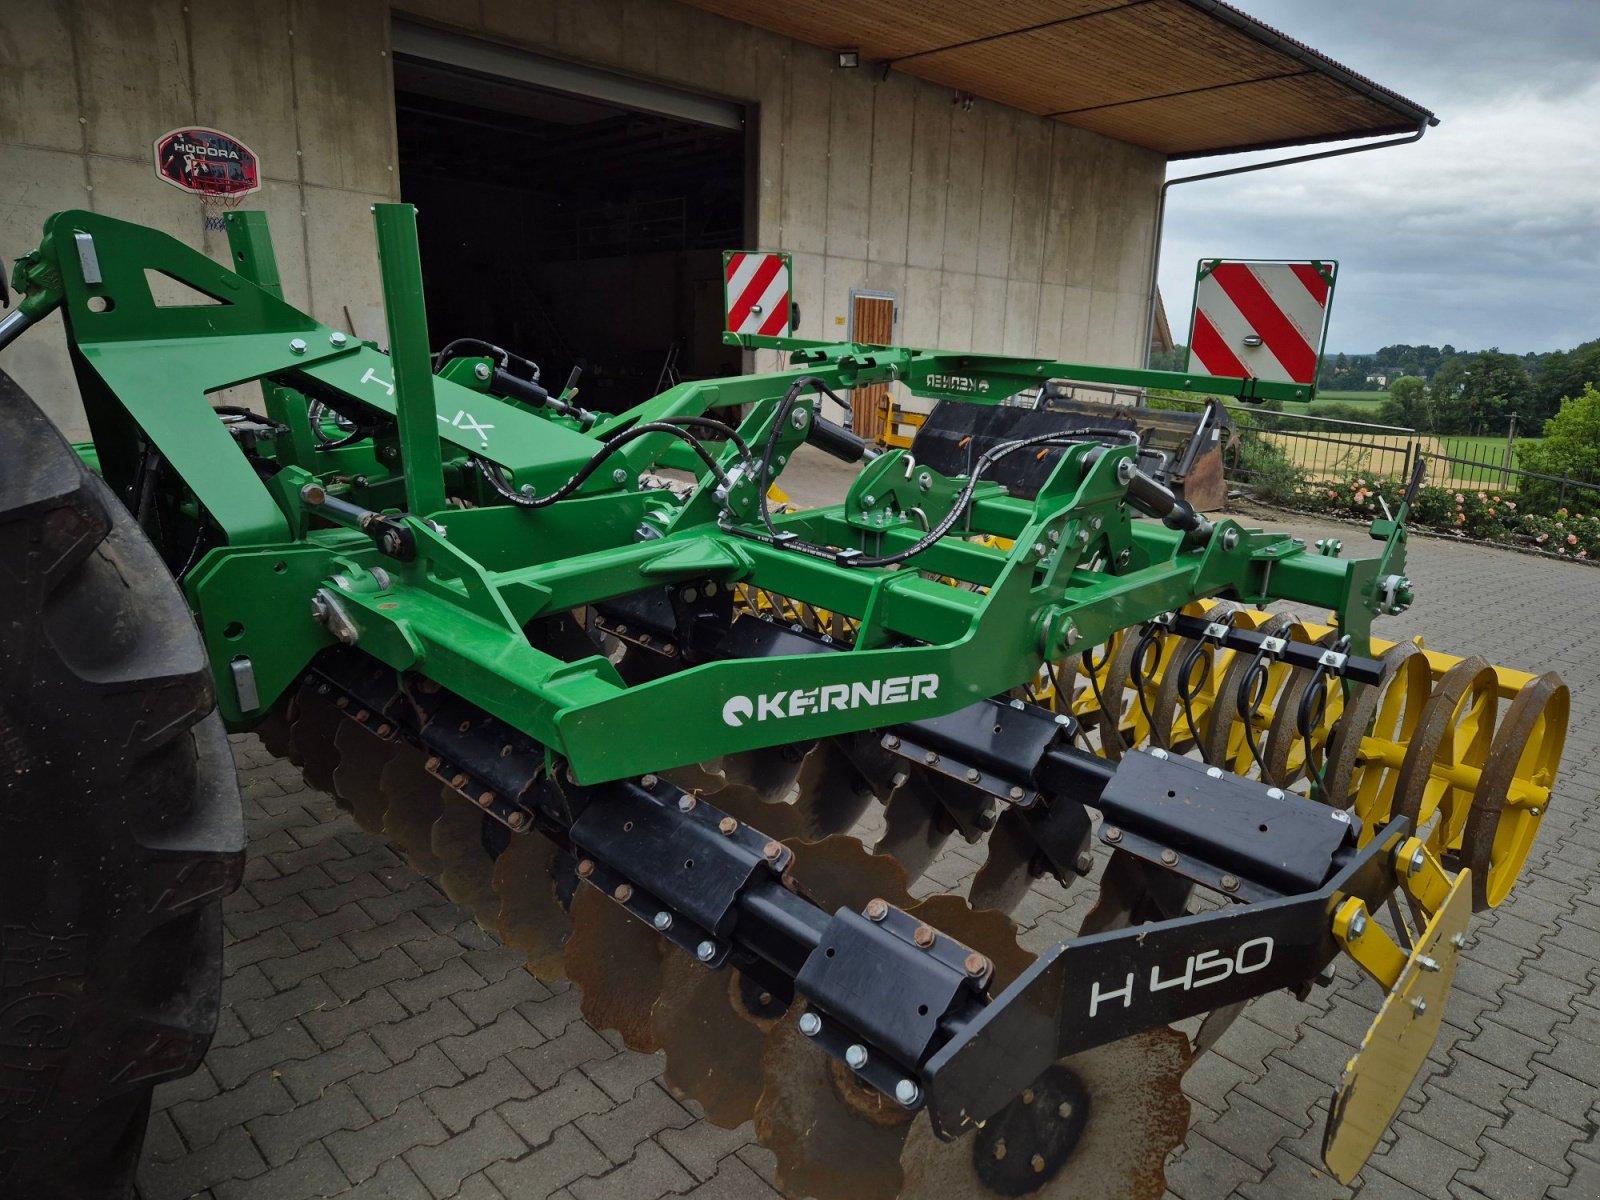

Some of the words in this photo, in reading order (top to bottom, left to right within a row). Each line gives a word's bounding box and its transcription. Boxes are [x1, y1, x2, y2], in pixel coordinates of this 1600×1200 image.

[757, 673, 939, 721] KERNER
[1089, 972, 1134, 1018] H
[1150, 936, 1274, 993] 450
